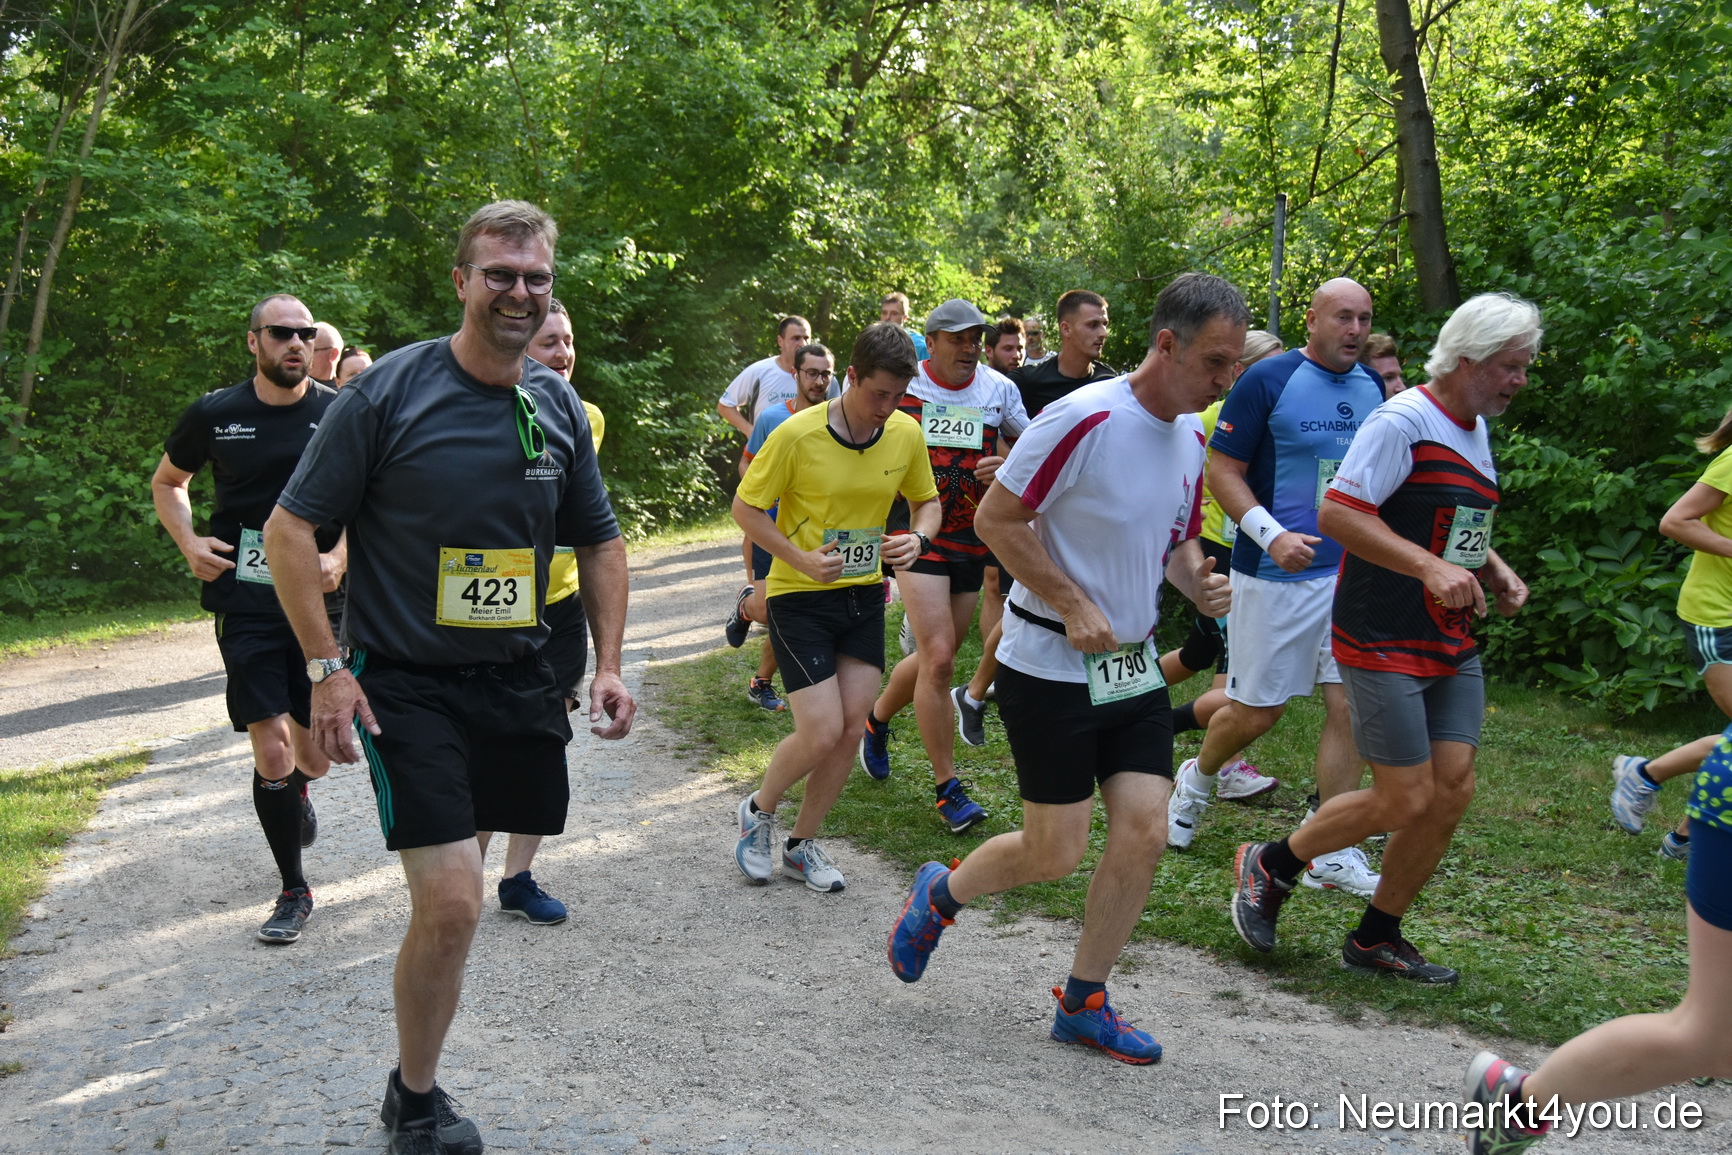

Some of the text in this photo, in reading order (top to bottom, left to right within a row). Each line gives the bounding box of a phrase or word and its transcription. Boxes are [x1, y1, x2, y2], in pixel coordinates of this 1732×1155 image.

[213, 426, 224, 434] Be
[928, 418, 975, 437] 2240
[1300, 420, 1363, 433] SCHABMÜ
[525, 468, 562, 476] BURKHARDT
[456, 563, 498, 574] firmenlauf
[461, 577, 518, 606] 423
[471, 607, 512, 615] Meier Emil
[1097, 651, 1147, 684] 1790
